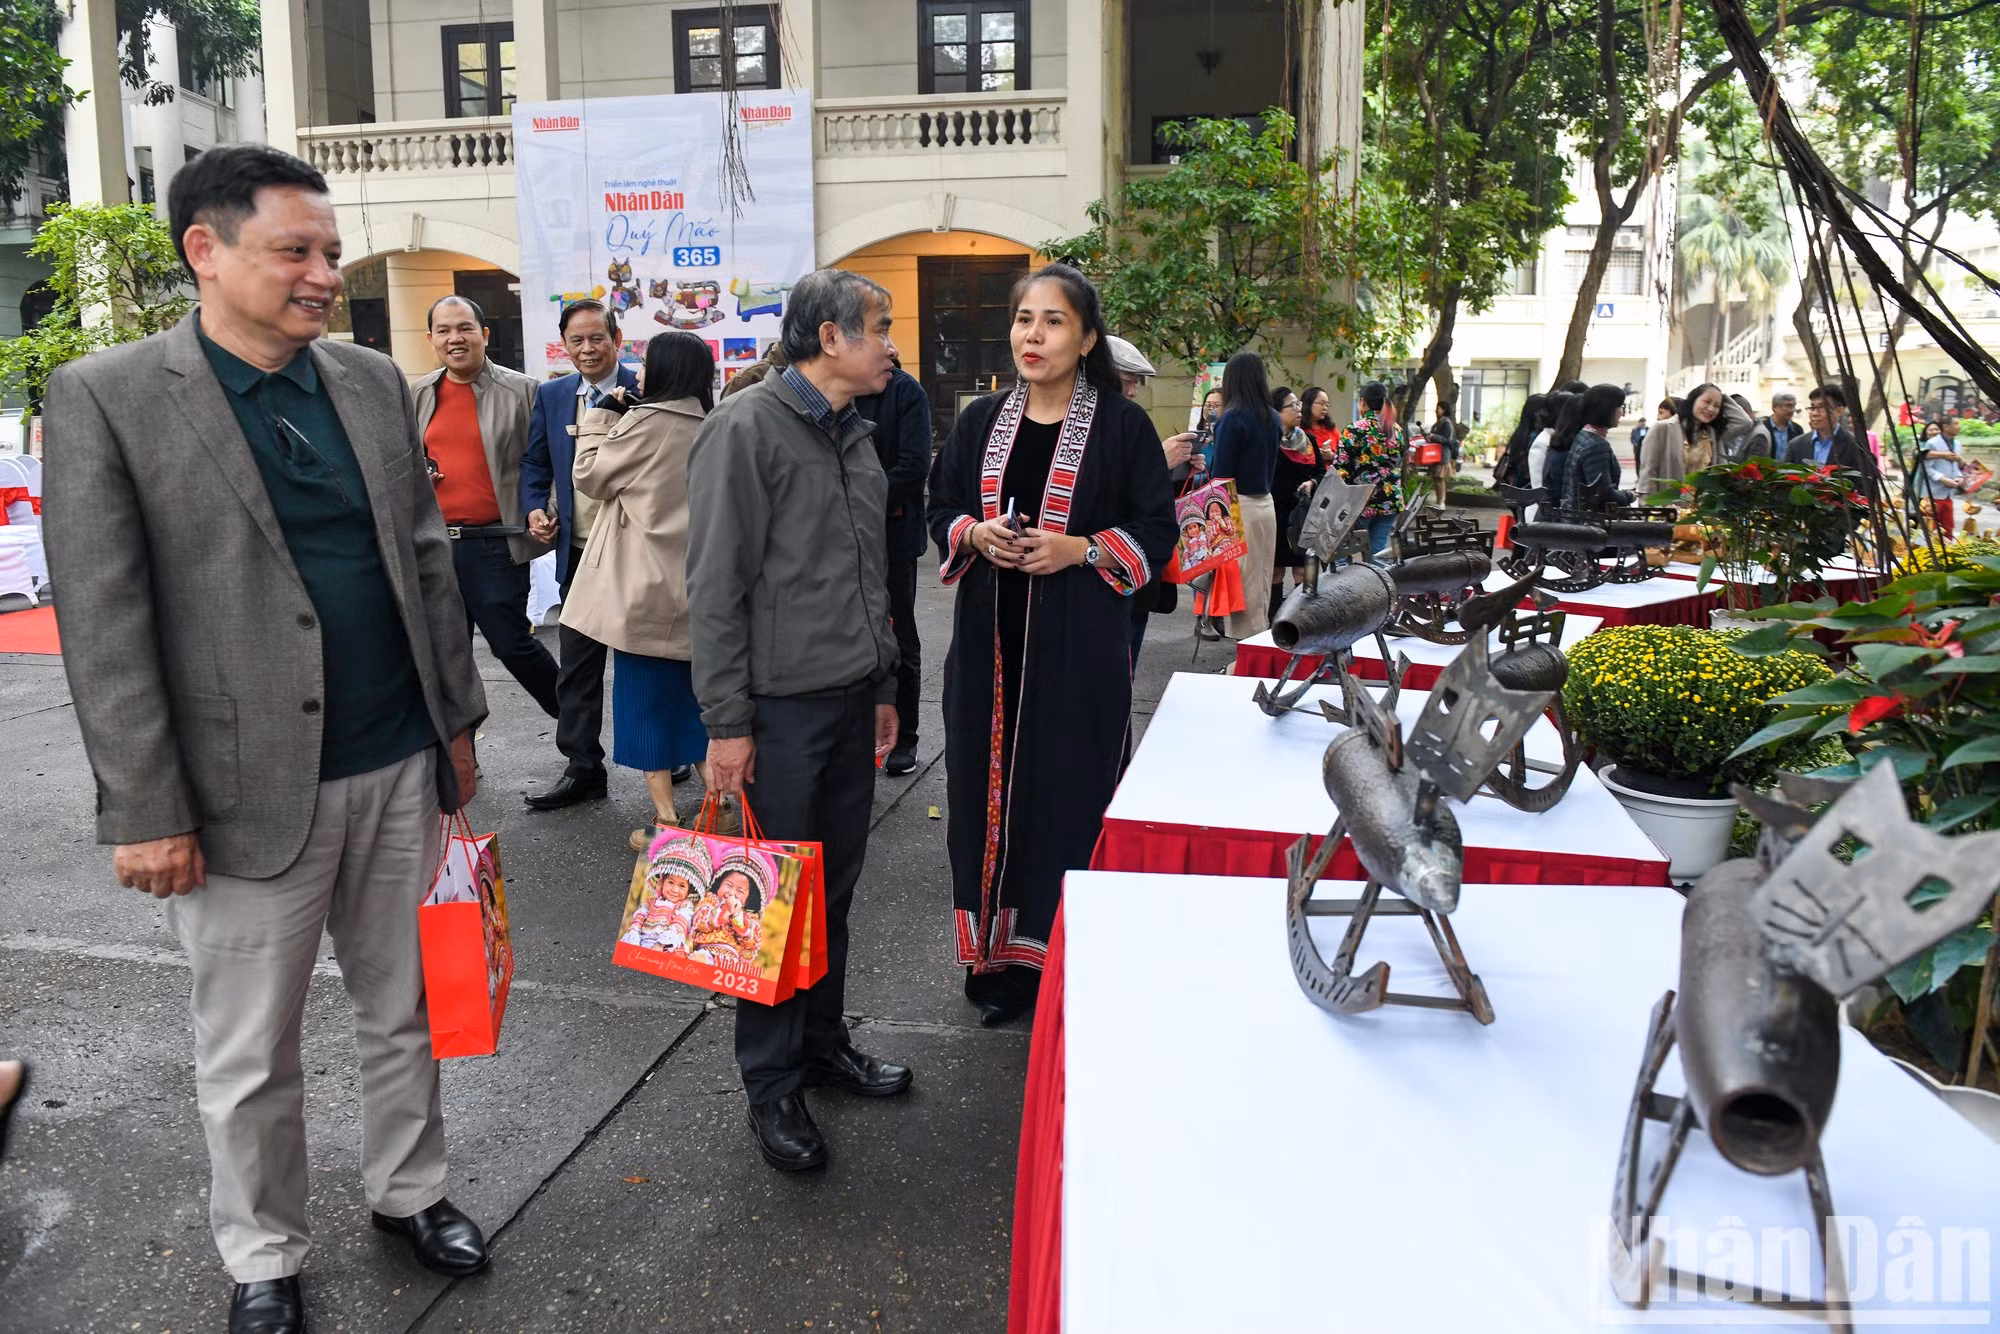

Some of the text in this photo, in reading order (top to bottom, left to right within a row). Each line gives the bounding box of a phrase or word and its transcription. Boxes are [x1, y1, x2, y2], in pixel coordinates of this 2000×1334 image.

[604, 180, 623, 188] Triển
[638, 180, 656, 189] nghệ
[657, 178, 677, 186] thuật
[605, 190, 685, 212] Nhân Dân
[606, 212, 720, 256] Quý Mão
[676, 248, 717, 266] 365
[1224, 545, 1242, 561] 2023
[712, 969, 759, 995] 2023
